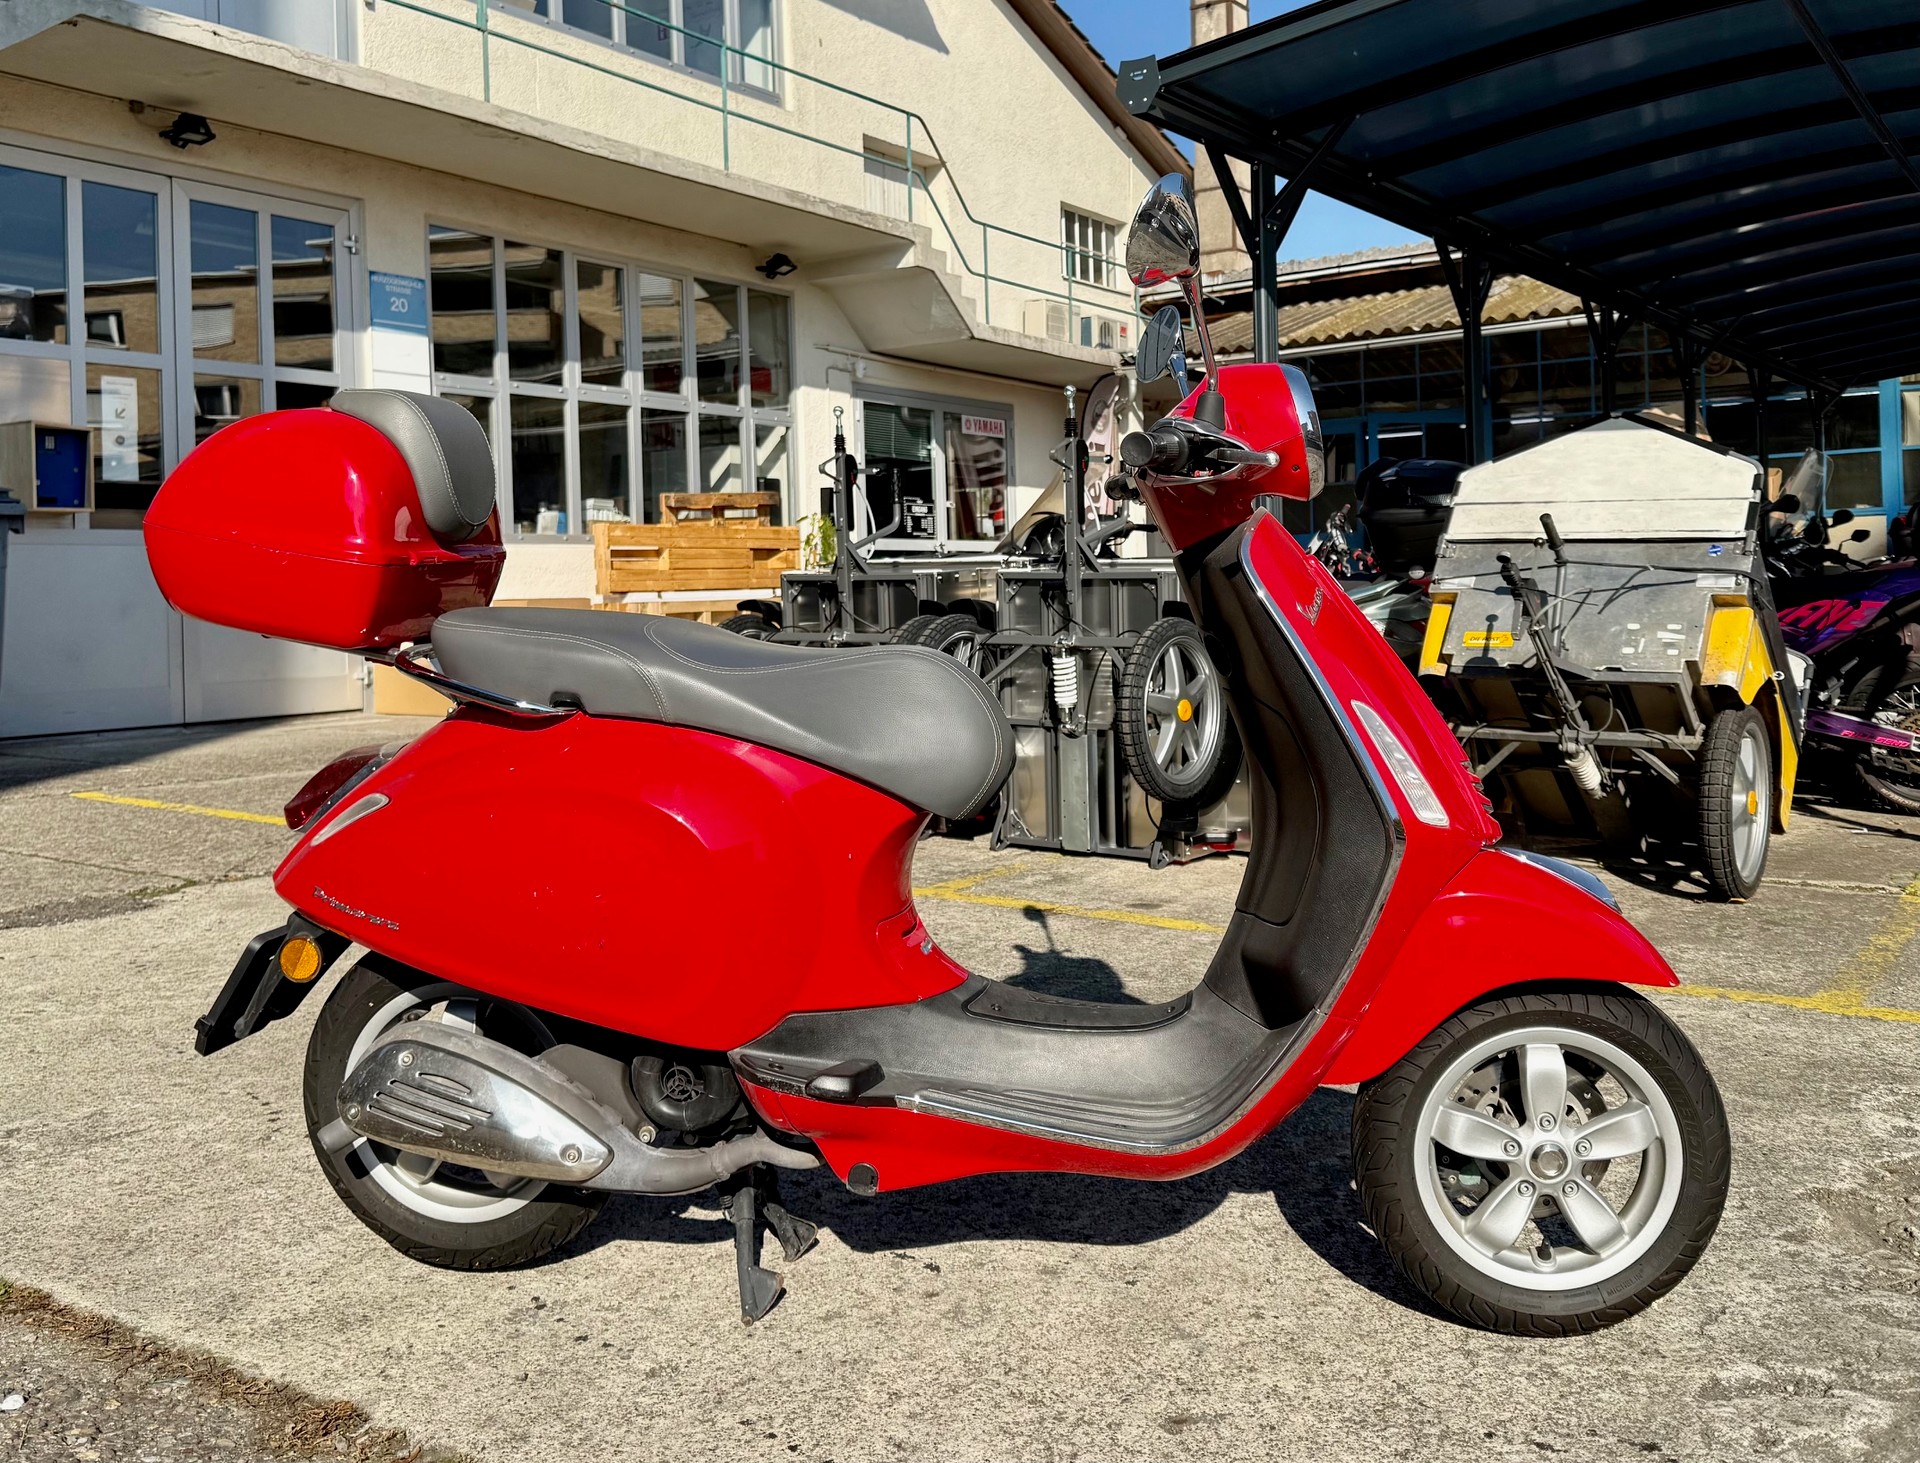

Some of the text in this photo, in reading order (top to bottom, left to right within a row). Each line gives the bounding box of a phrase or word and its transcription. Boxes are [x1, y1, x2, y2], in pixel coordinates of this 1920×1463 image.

[390, 297, 408, 313] 20
[973, 418, 1004, 436] YAMAHA
[1874, 736, 1911, 748] SEND
[1605, 1271, 1645, 1297] MICHELIN
